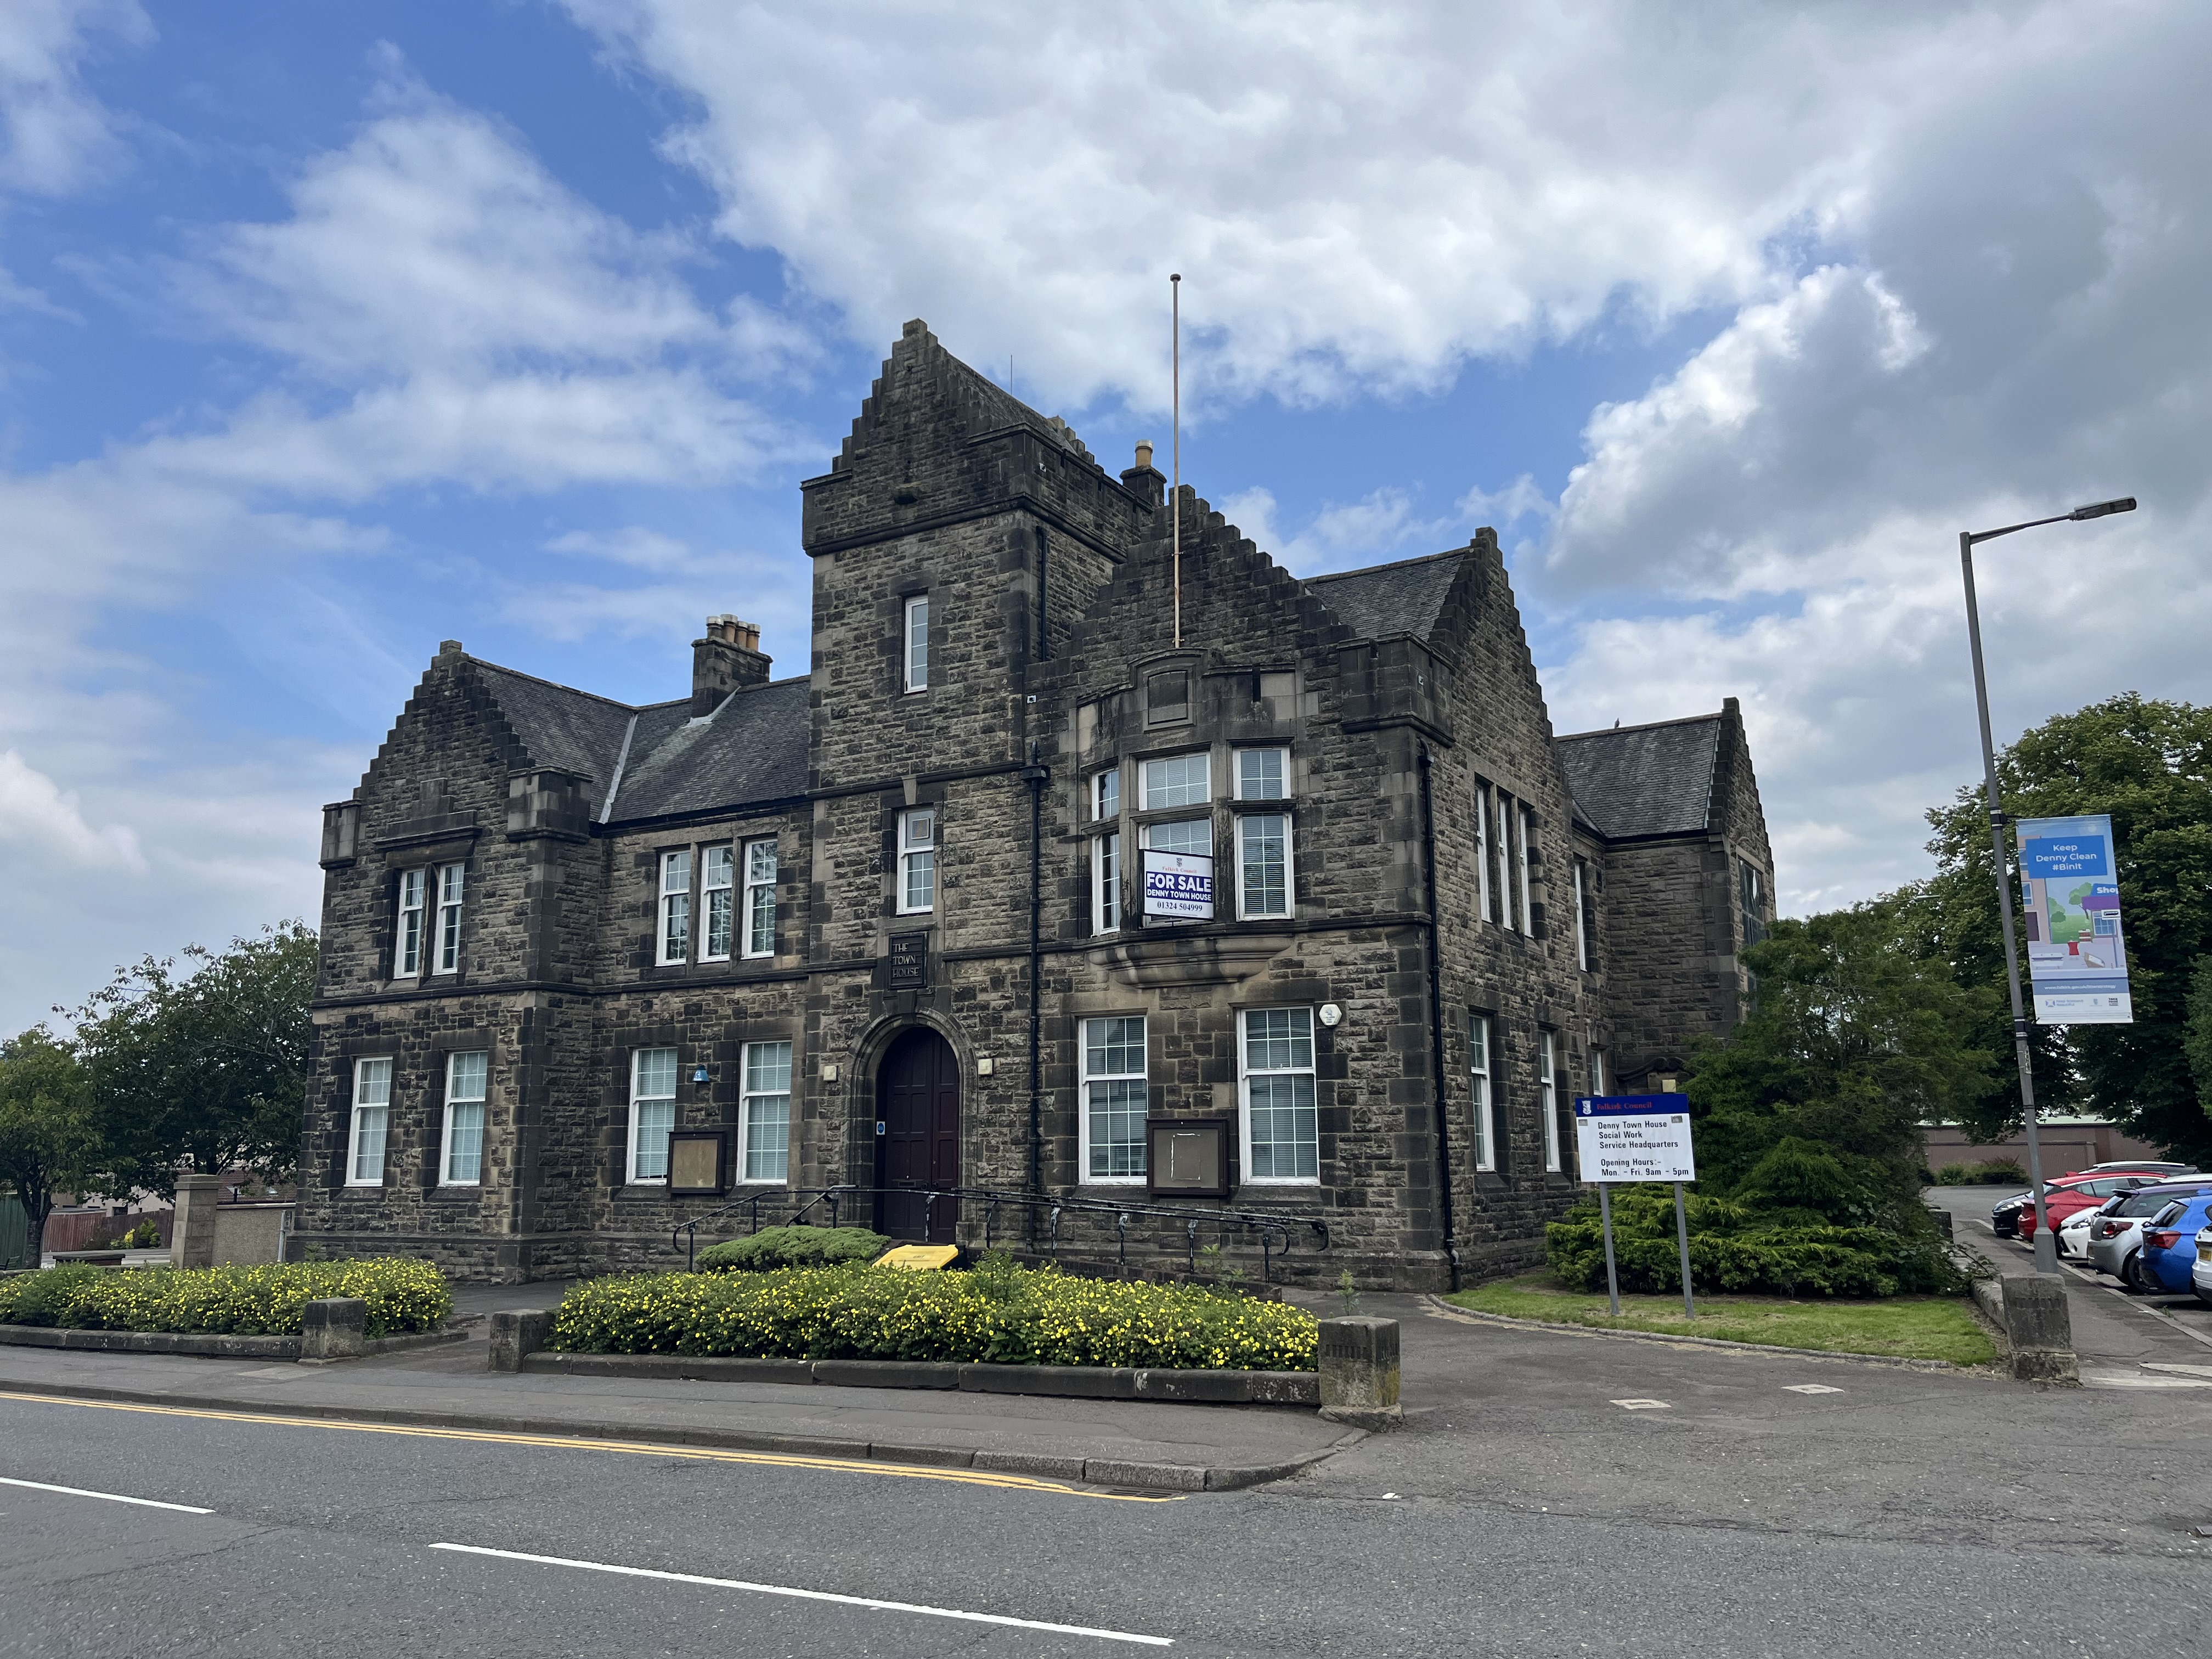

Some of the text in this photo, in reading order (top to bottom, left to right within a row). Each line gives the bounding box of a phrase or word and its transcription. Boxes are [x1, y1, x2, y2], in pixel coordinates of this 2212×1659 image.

[2036, 855, 2067, 863] Denny
[1147, 873, 1211, 893] FOR SALE
[1147, 889, 1169, 898] DENNY
[1170, 890, 1189, 899] TOWN
[1157, 901, 1203, 912] 01324 504999
[893, 943, 909, 952] THE
[893, 955, 916, 965] TOWN
[893, 967, 919, 978] HOUSE
[1598, 1121, 1619, 1130] Denny
[1629, 1141, 1678, 1149] Headquarters
[1601, 1159, 1629, 1167] Opening
[1673, 1168, 1689, 1176] 5pm
